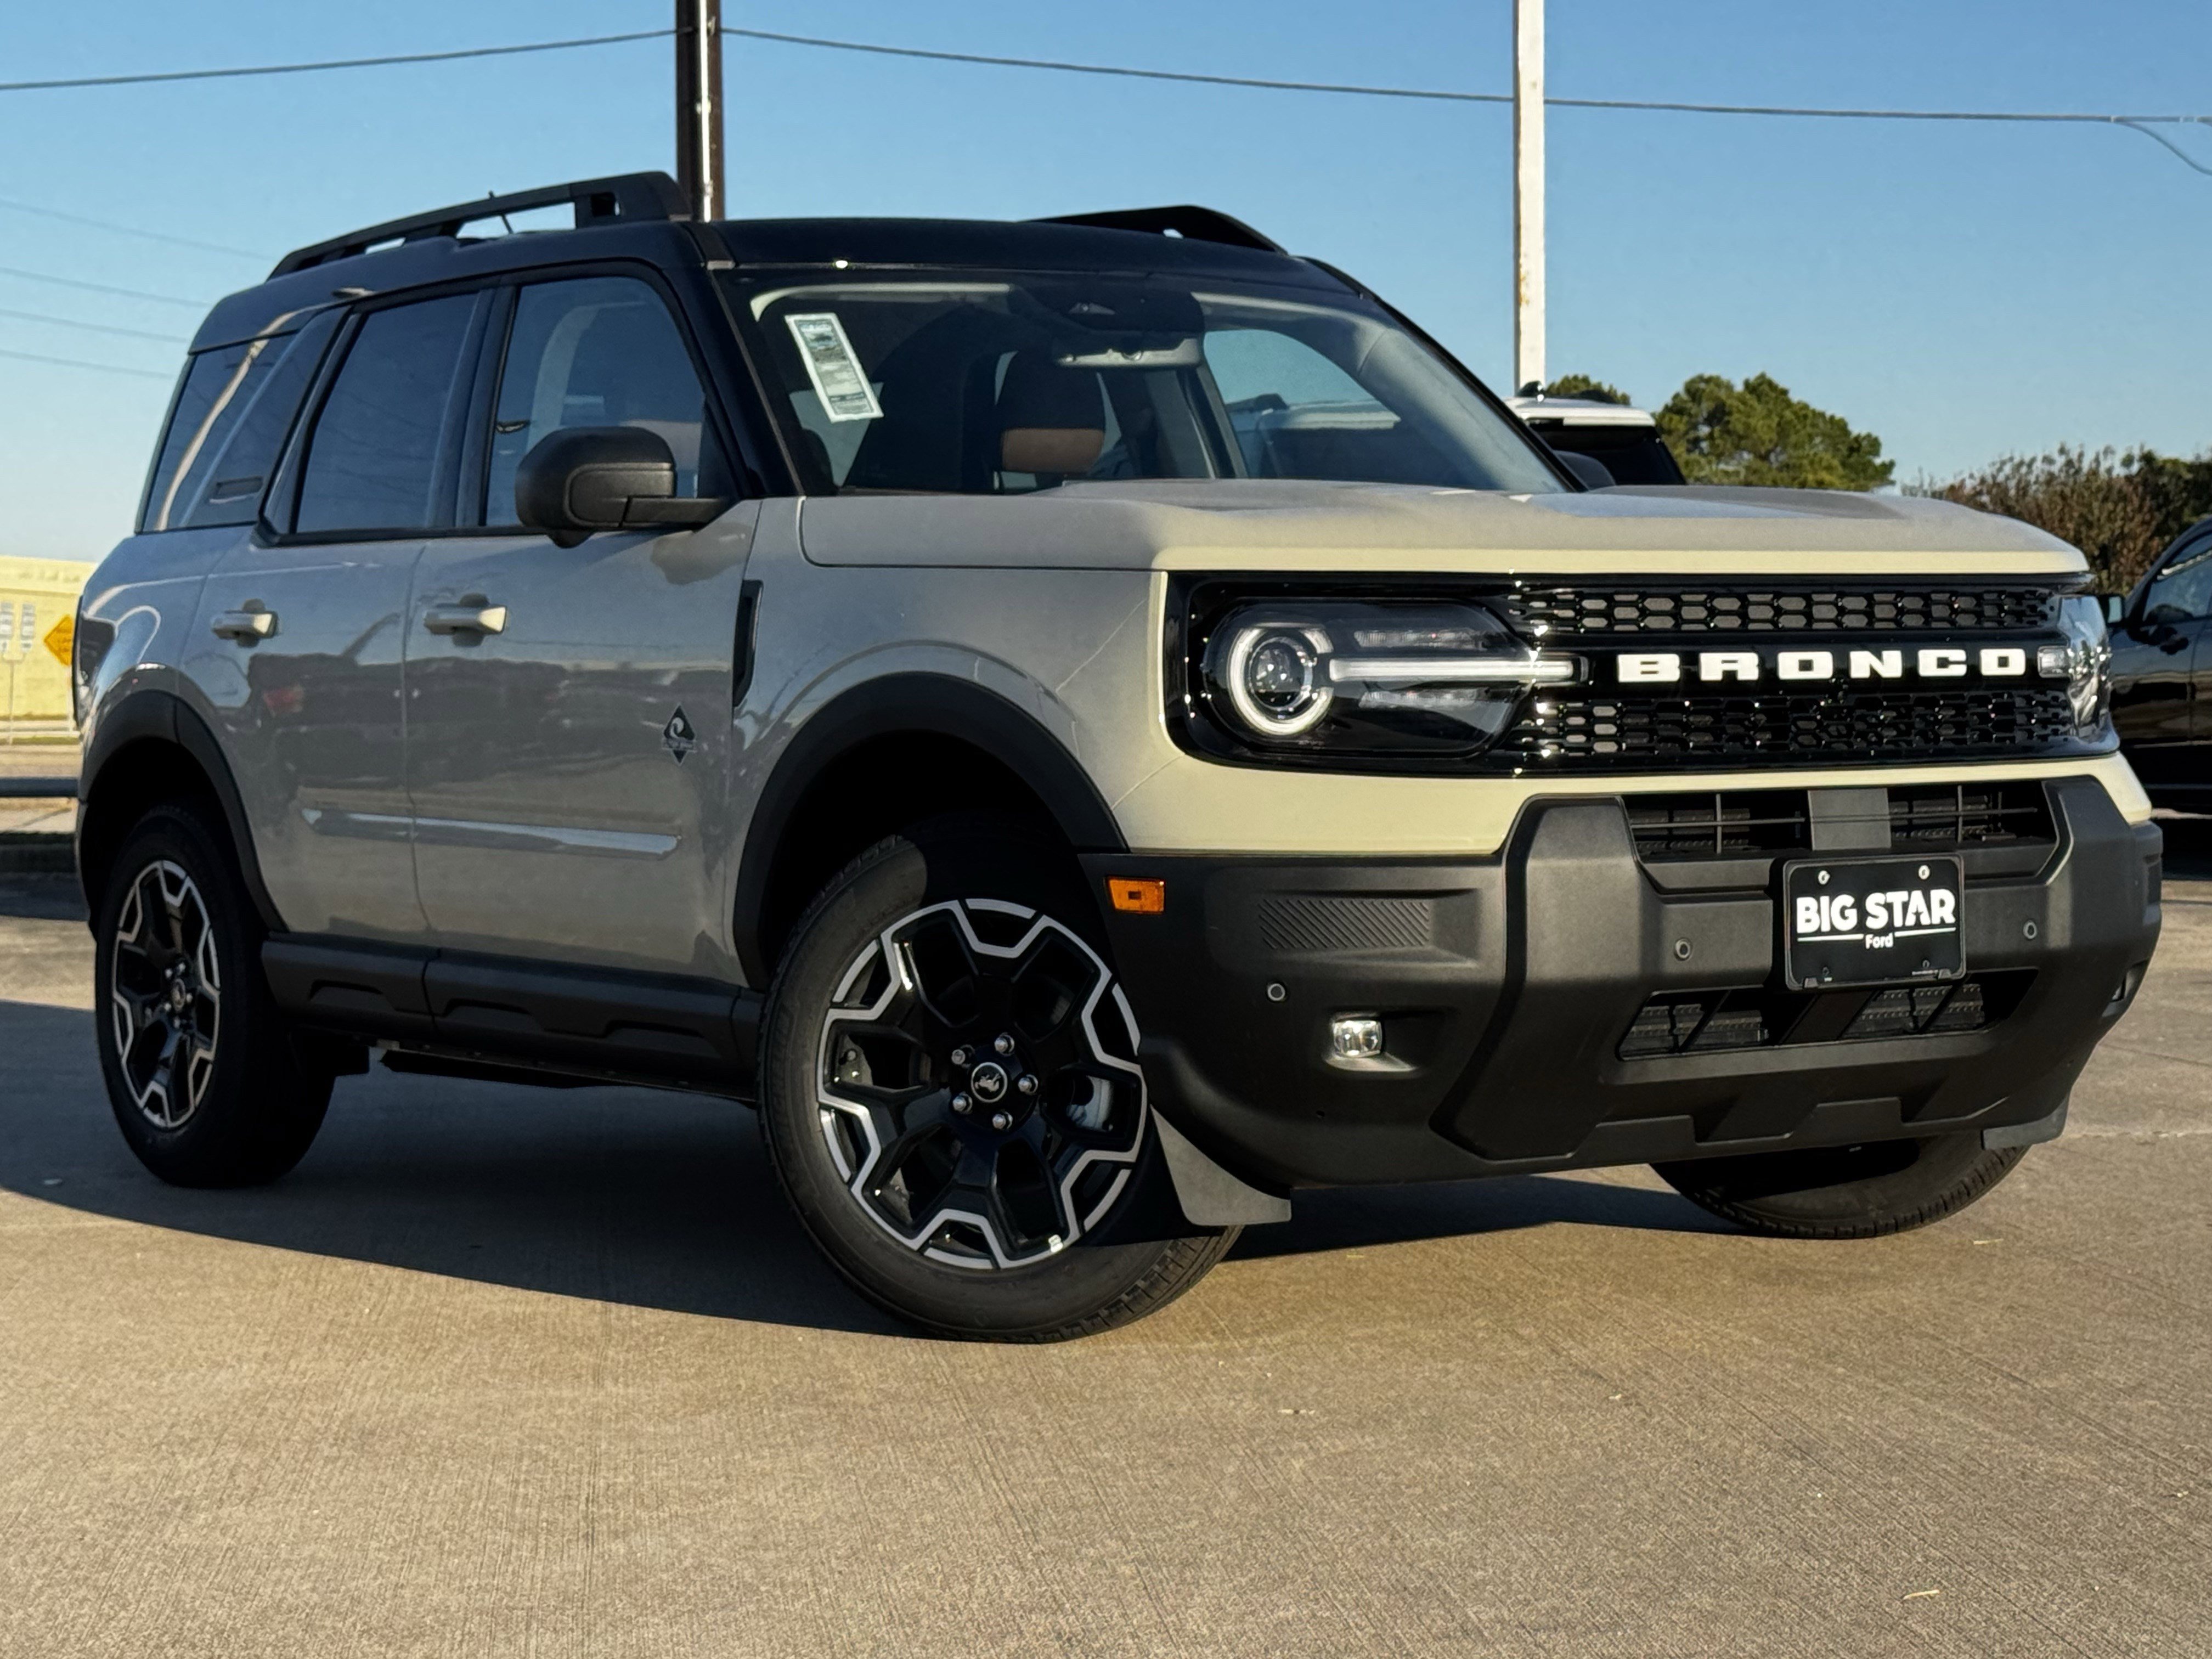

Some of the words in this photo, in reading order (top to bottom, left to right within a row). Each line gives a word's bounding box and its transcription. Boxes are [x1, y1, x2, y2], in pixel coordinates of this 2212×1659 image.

[1617, 648, 2026, 682] BRONCO
[1796, 894, 1858, 933] BIG
[1865, 889, 1956, 929] STAR
[1865, 933, 1894, 949] Ford
